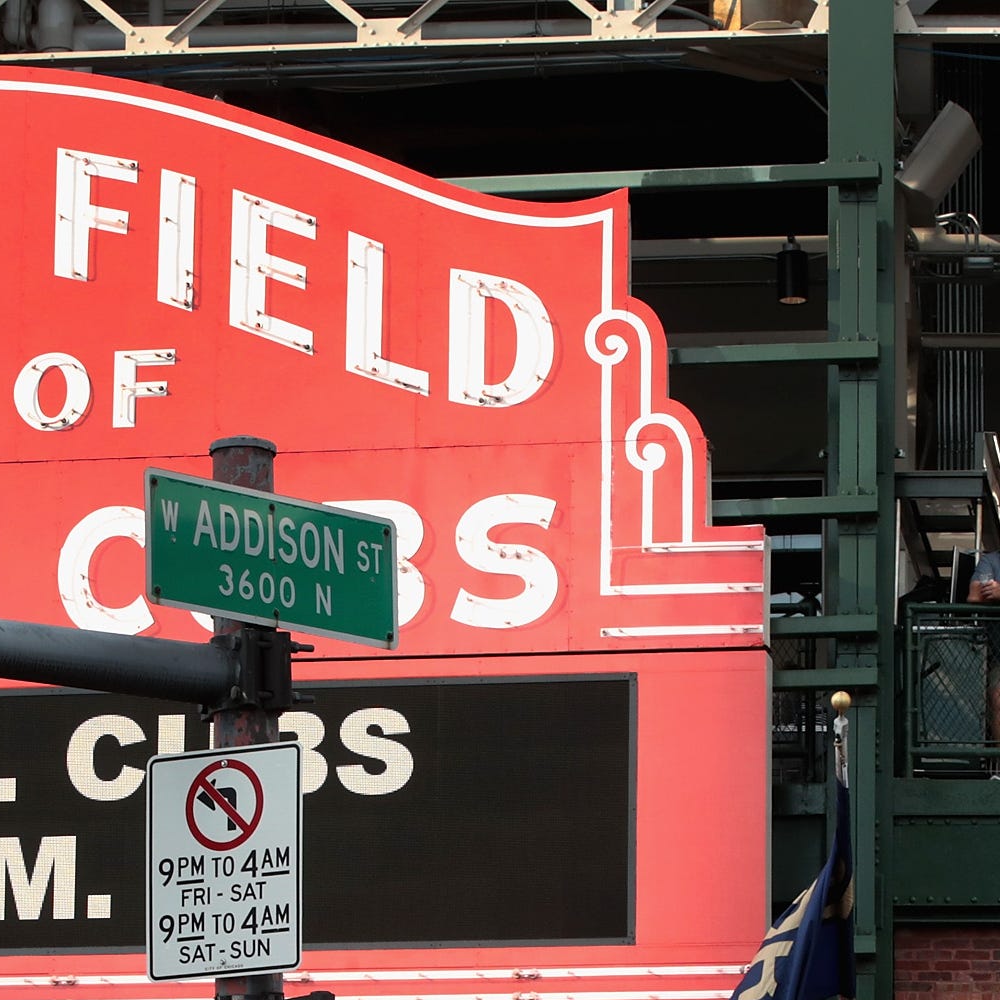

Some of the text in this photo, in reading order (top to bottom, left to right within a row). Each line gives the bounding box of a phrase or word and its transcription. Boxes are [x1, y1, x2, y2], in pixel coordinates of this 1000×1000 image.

[54, 147, 556, 408] FIELD
[13, 347, 177, 432] OF
[161, 499, 384, 576] W ADDISON ST
[219, 563, 332, 617] 3600 N
[66, 707, 414, 802] CBS
[158, 846, 290, 887] 9PM TO 4AM
[181, 886, 211, 907] FRI
[230, 881, 267, 902] SAT
[158, 903, 290, 944] 9PM TO 4AM
[179, 943, 216, 964] SAT
[230, 938, 270, 959] SUN
